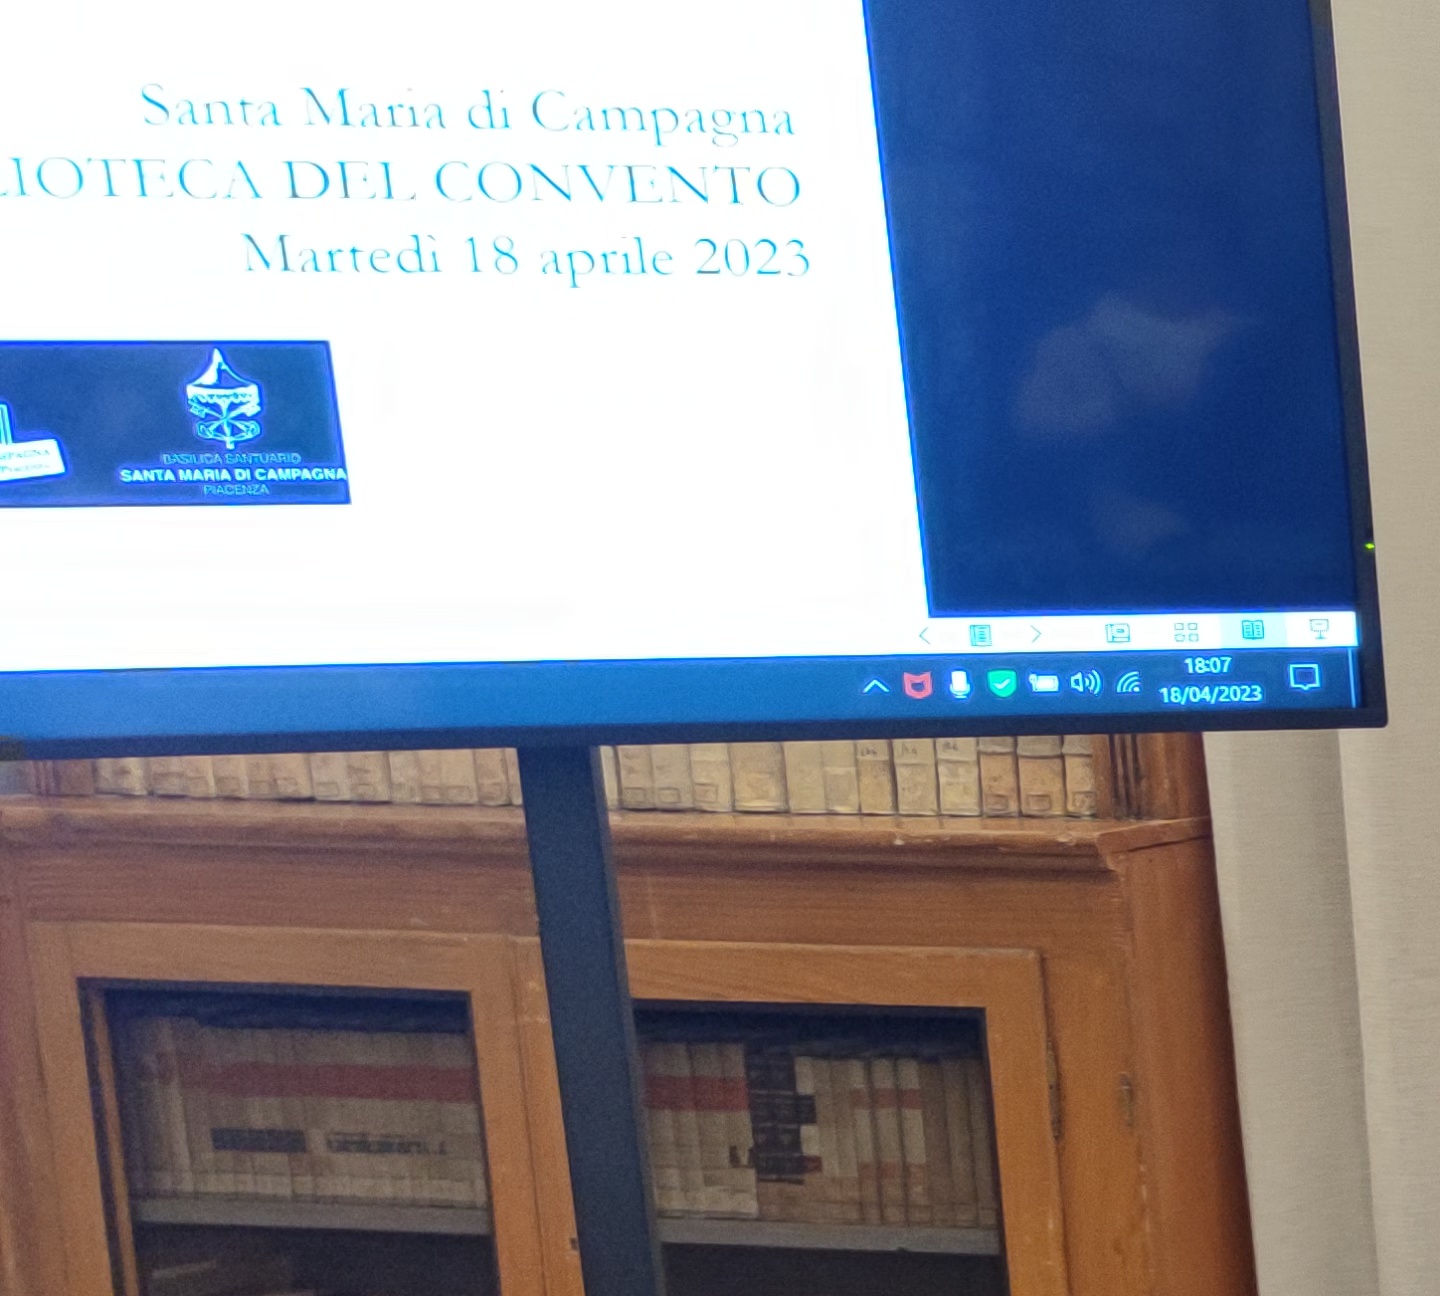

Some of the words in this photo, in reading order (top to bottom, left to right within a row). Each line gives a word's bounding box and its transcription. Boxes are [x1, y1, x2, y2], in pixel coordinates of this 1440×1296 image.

[140, 83, 283, 126] Santa
[300, 87, 447, 129] Maria
[467, 89, 511, 130] di
[532, 89, 796, 147] Campagna
[0, 156, 264, 200] IOTECA
[282, 160, 417, 200] DEL
[435, 161, 801, 207] CONVENTO
[240, 232, 442, 274] Martedì
[464, 235, 519, 275] 18
[540, 235, 674, 289] aprile
[693, 238, 810, 277] 2023
[162, 453, 223, 465] BASILICA
[119, 468, 176, 483] SANTA
[178, 467, 231, 482] MARIA
[234, 467, 252, 482] DI
[254, 467, 348, 482] CAMPAGNA
[203, 484, 270, 496] PIACENZA
[1184, 656, 1231, 675] 18:07
[1159, 684, 1264, 705] 18/04/2023
